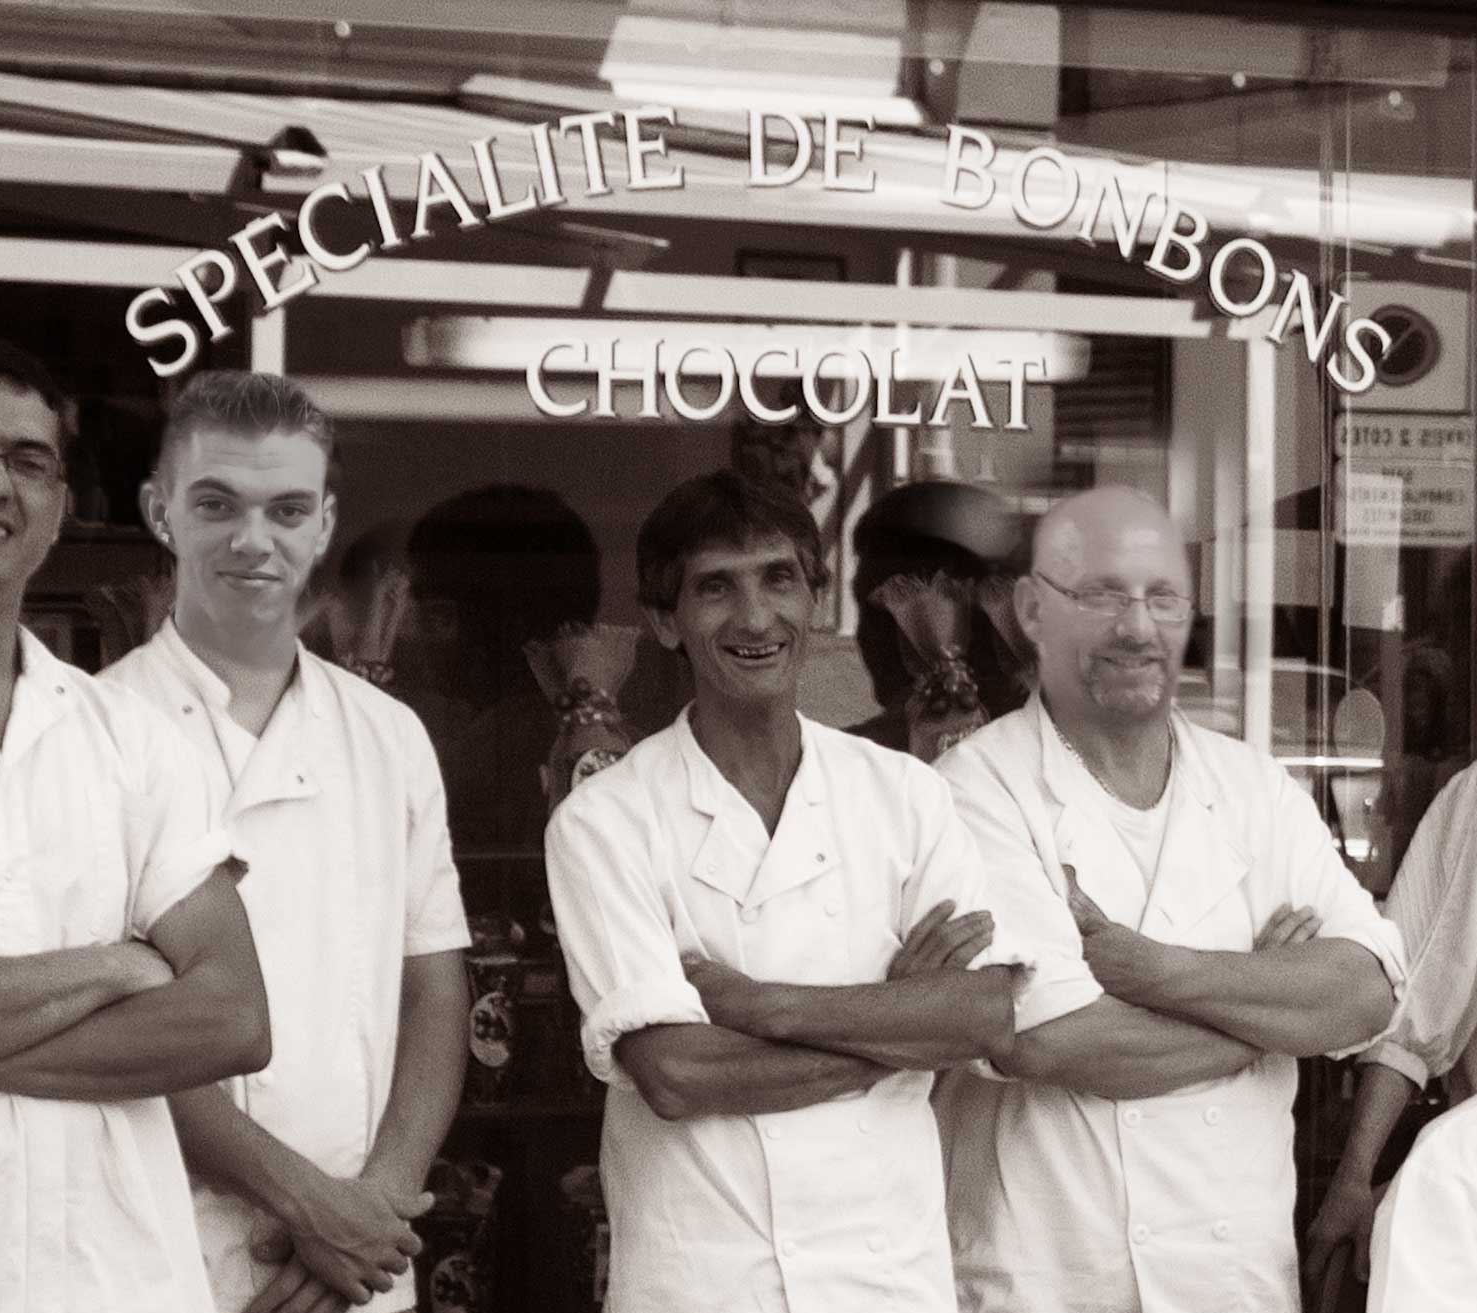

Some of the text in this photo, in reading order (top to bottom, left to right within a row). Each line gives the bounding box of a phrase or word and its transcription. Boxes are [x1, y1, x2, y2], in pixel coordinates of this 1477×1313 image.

[744, 108, 877, 193] DE
[940, 123, 1394, 394] BONBONS
[525, 337, 1049, 431] CHOCOLAT
